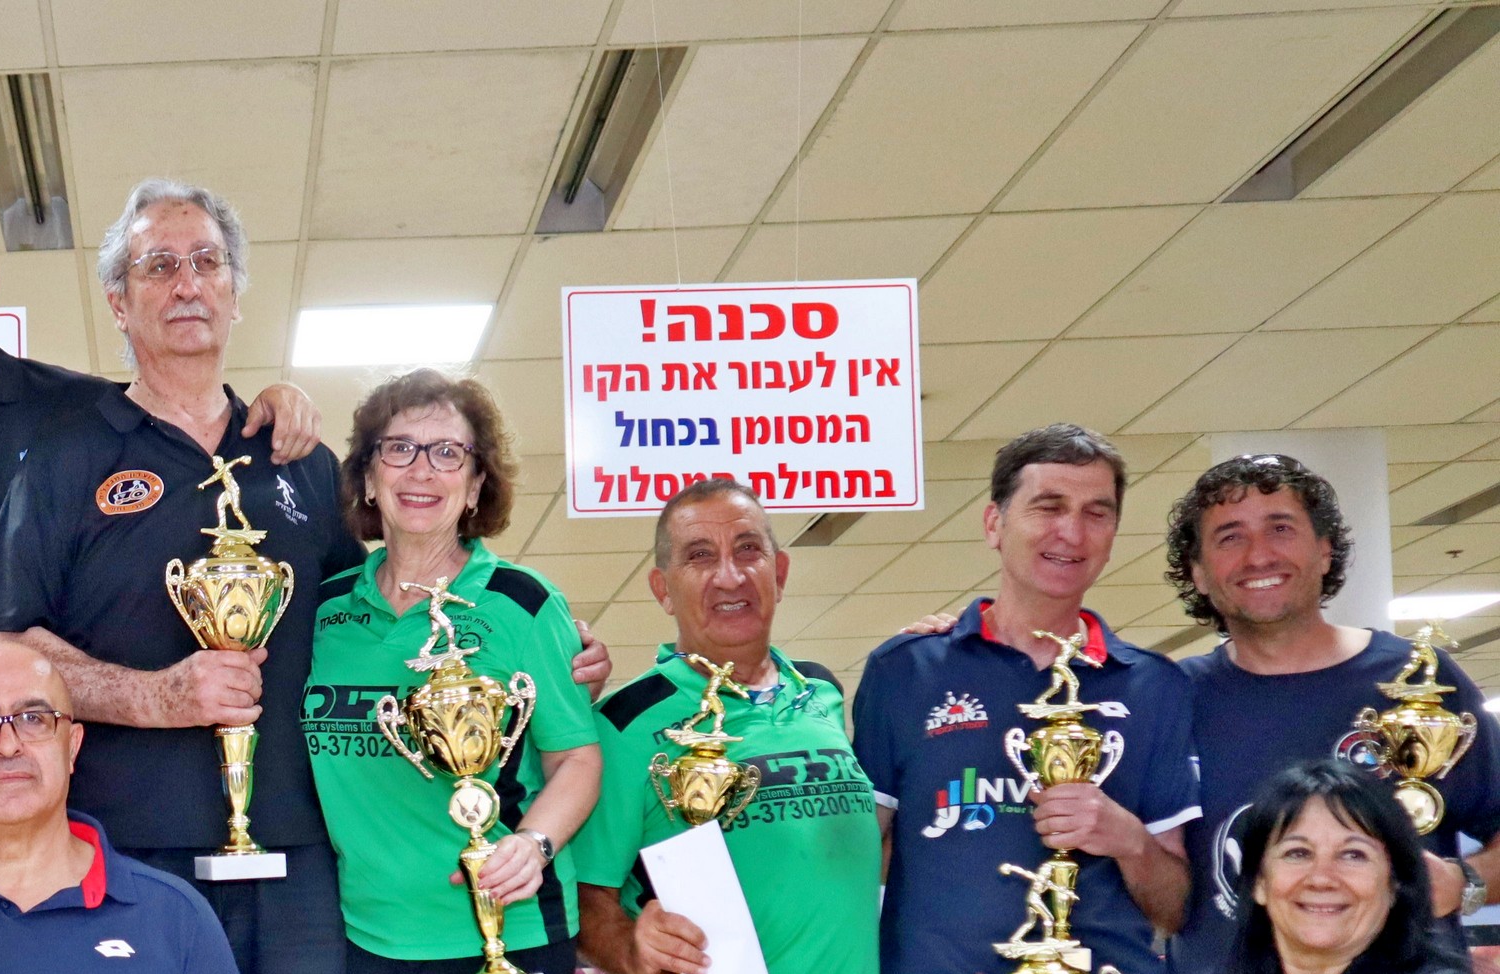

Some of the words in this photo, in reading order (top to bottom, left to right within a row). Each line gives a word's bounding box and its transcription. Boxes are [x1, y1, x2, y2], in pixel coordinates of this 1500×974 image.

[640, 299, 839, 342] סכנה!
[583, 363, 650, 401] הקו
[661, 362, 718, 391] את
[728, 351, 836, 394] לעבור
[848, 358, 901, 396] אין
[615, 411, 720, 447] בכחול
[731, 414, 871, 454] המסומן
[594, 465, 736, 502] סלול
[748, 463, 897, 499] בתחילת
[320, 722, 359, 733] systems
[360, 722, 373, 732] ltd
[754, 786, 792, 801] ystems
